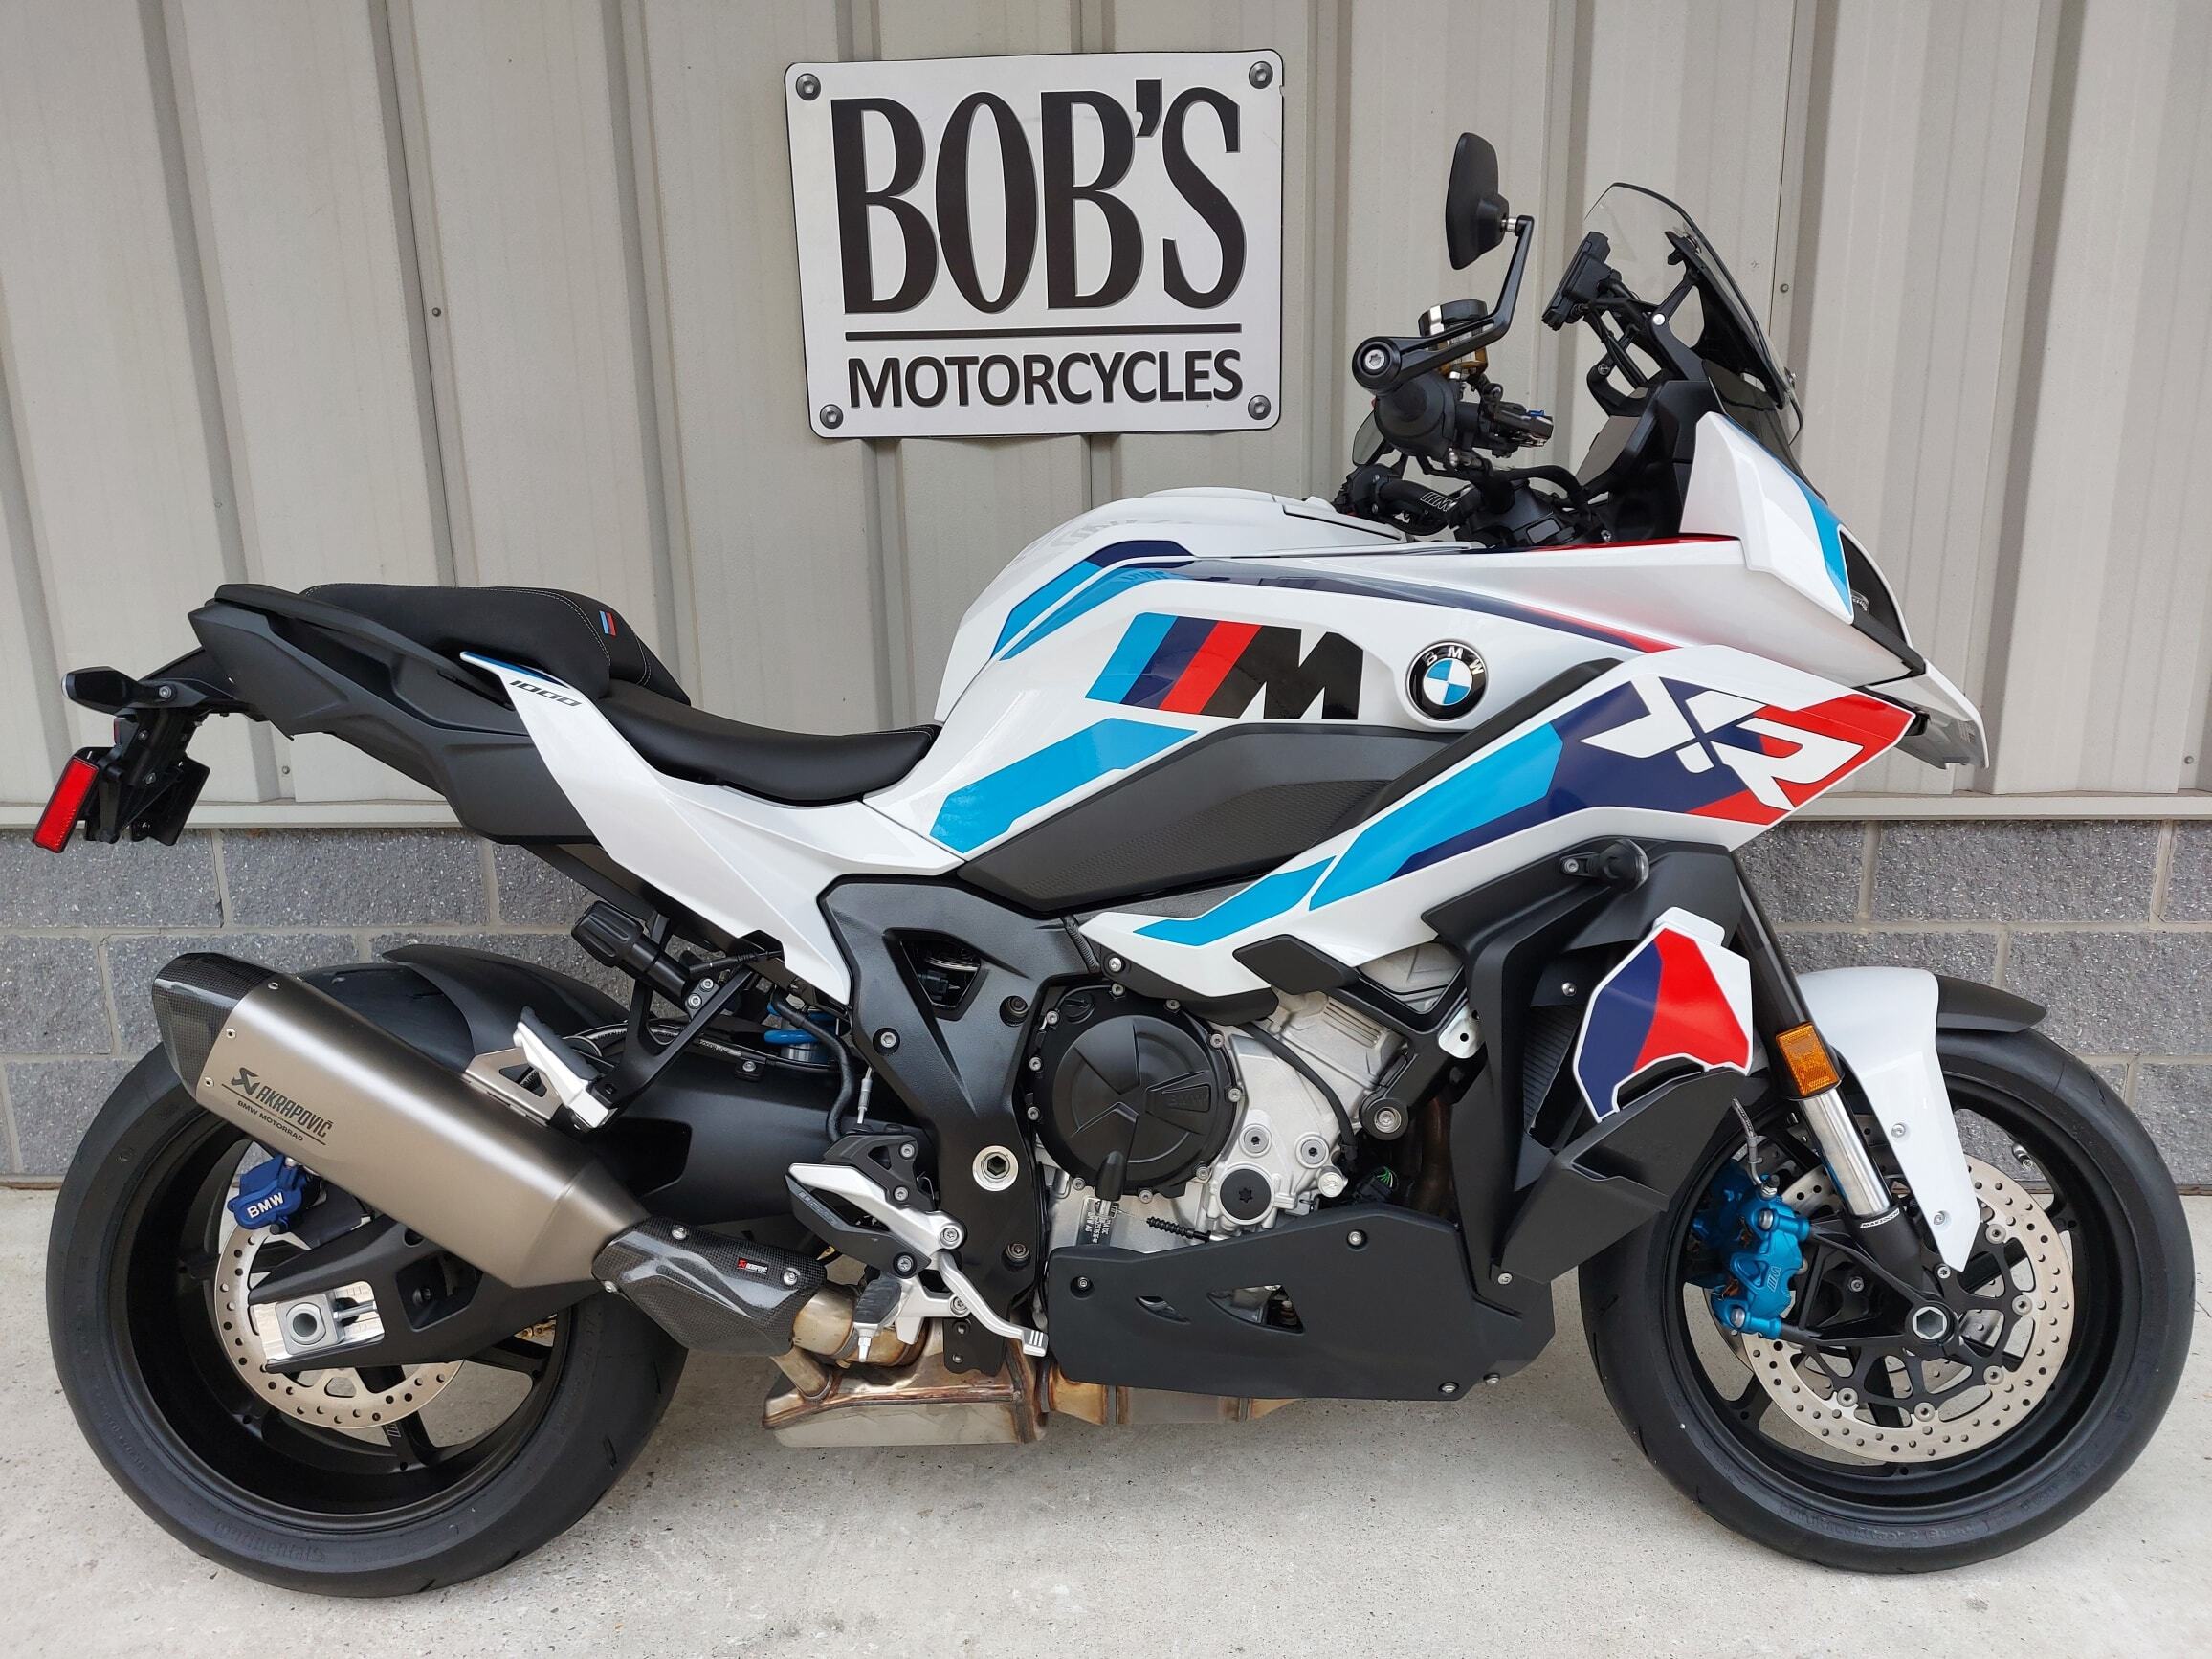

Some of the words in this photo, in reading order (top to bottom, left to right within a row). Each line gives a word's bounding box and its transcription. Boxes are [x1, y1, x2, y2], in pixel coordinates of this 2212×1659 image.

[830, 78, 1246, 314] BOB'S
[847, 349, 1243, 409] MOTORCYCLES
[1422, 645, 1485, 675] BMW
[509, 680, 582, 706] 1000
[237, 1100, 258, 1116] BMW
[259, 1113, 304, 1141] MOTORRAD
[247, 1192, 284, 1219] BMW
